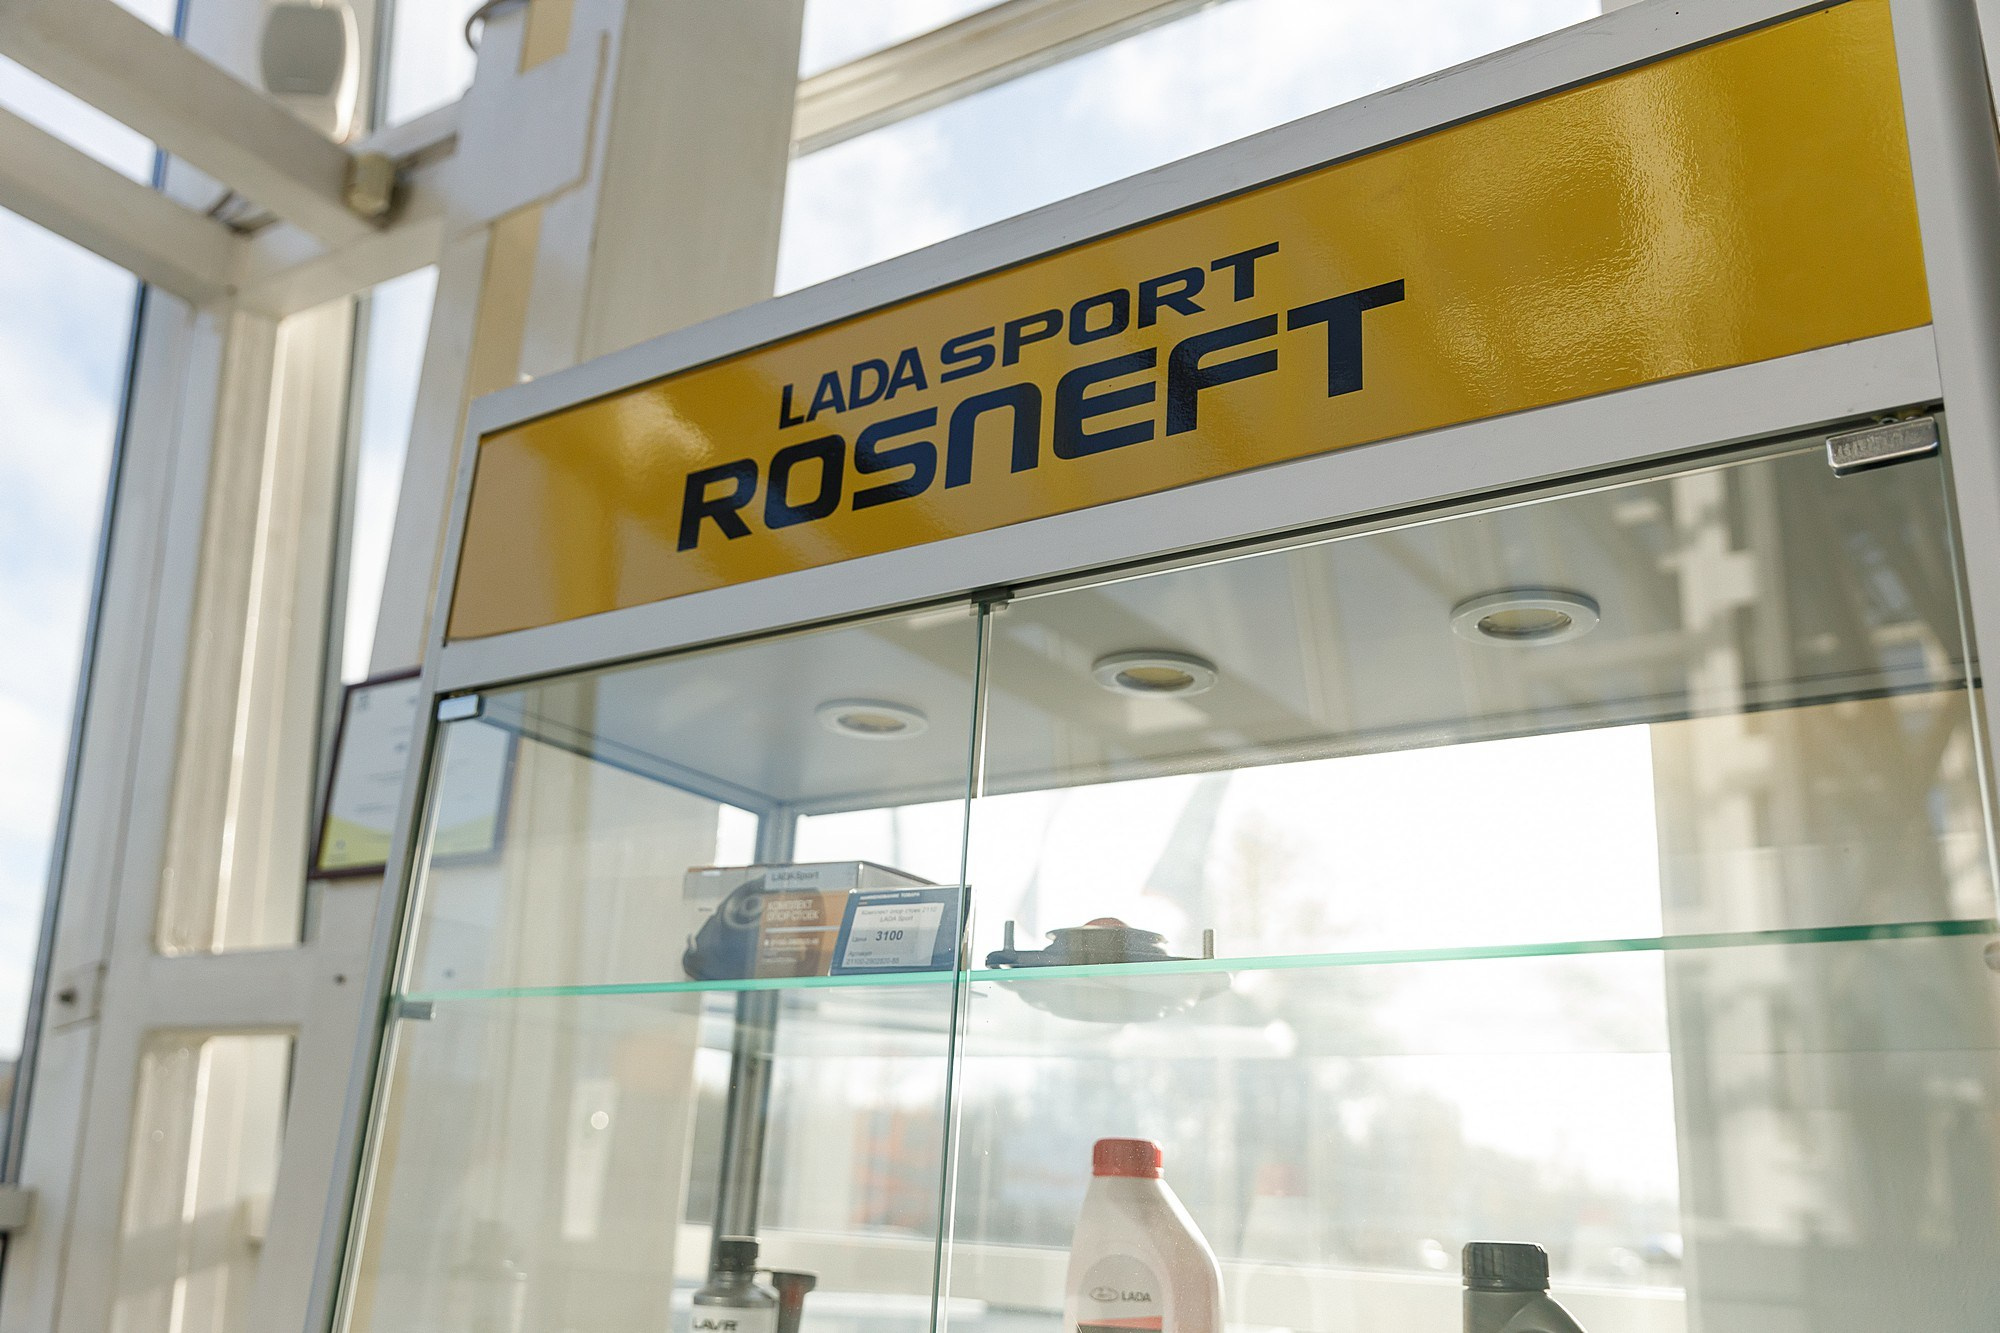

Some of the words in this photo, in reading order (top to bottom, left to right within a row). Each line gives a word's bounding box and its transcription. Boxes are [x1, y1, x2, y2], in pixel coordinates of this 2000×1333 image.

[779, 346, 928, 430] LADA
[940, 241, 1280, 384] SPORT
[676, 278, 1405, 552] ROSNEFT
[875, 930, 903, 941] 3100
[1121, 1291, 1151, 1302] LADA
